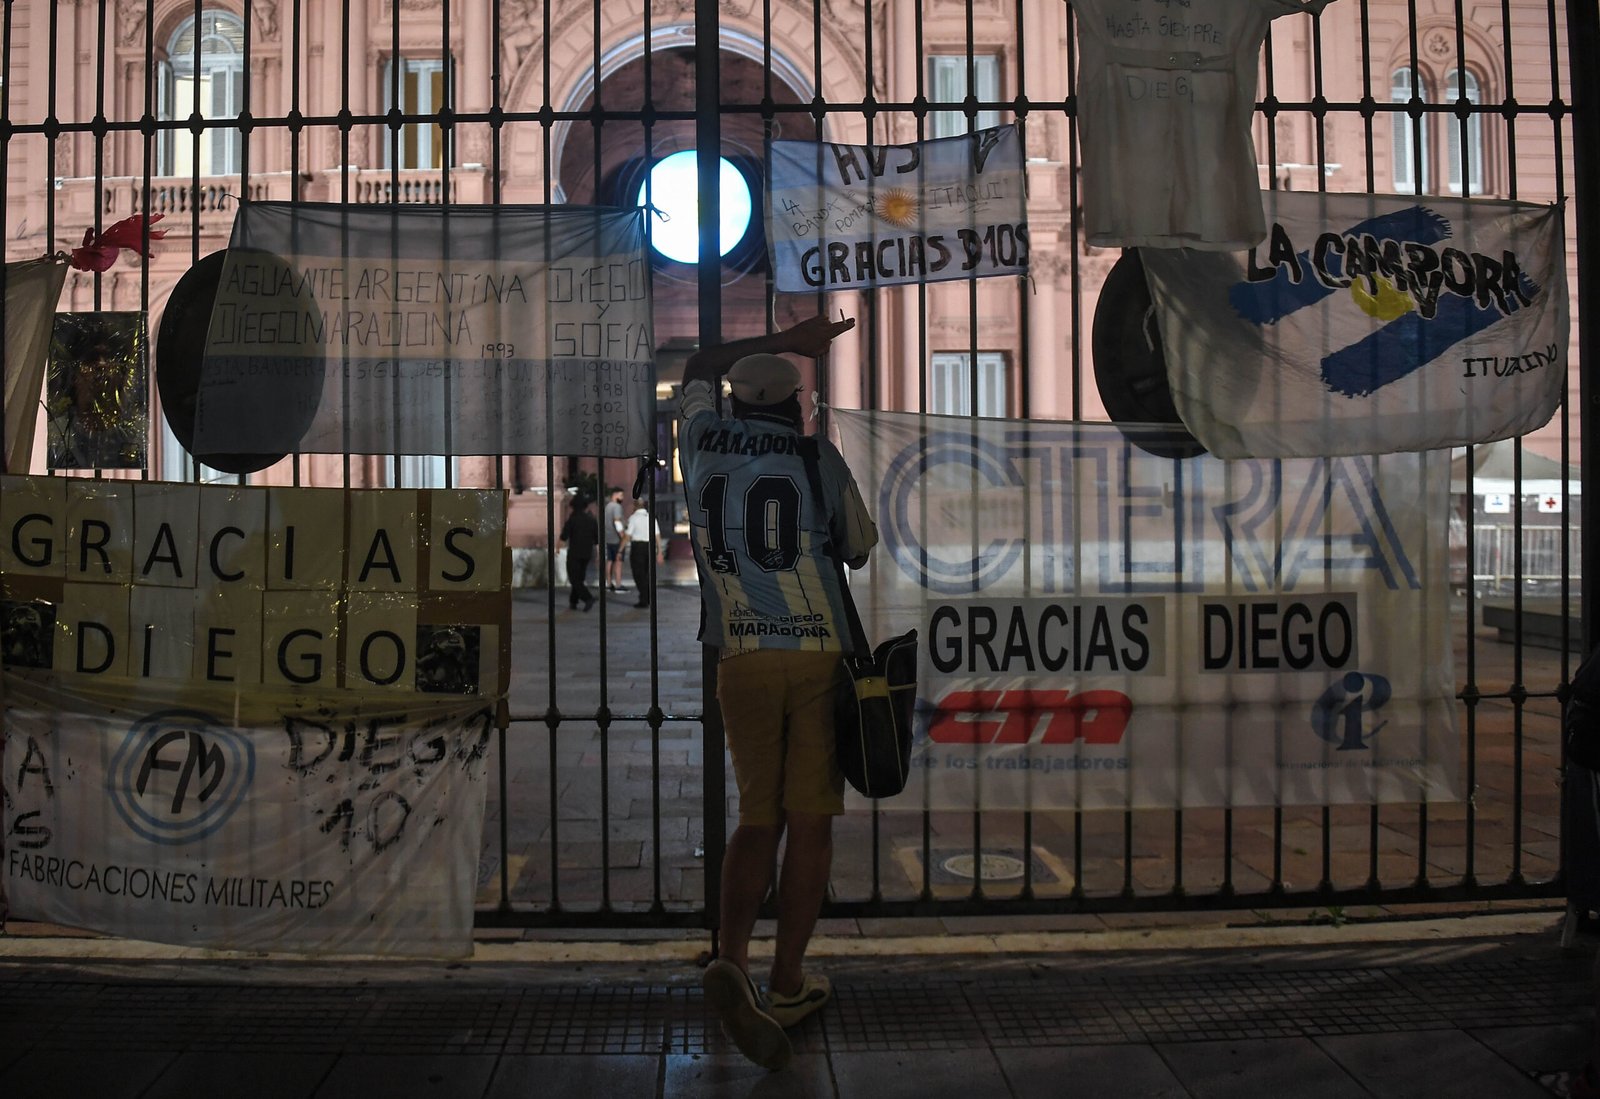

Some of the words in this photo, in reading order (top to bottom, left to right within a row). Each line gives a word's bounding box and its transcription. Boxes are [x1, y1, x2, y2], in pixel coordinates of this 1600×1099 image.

[801, 234, 953, 287] GRACIAS
[1250, 222, 1302, 284] LA
[225, 263, 344, 300] AGUANTE
[304, 310, 473, 347] MARADONA
[481, 343, 515, 358] 1993
[580, 402, 625, 416] 2002
[583, 383, 623, 399] 1998
[580, 421, 626, 434] 2006
[11, 513, 475, 582] GRACIAS
[700, 474, 803, 577] 10
[729, 622, 831, 638] MARADONA
[929, 603, 1149, 672] GRACIAS
[1203, 602, 1352, 670] DIEGO
[76, 621, 406, 685] DIEGO
[928, 689, 1133, 745] CTA
[945, 753, 979, 770] los
[986, 753, 1129, 774] trabajadores
[9, 849, 199, 904] FABRICACIONES
[205, 877, 334, 909] MILITARES
